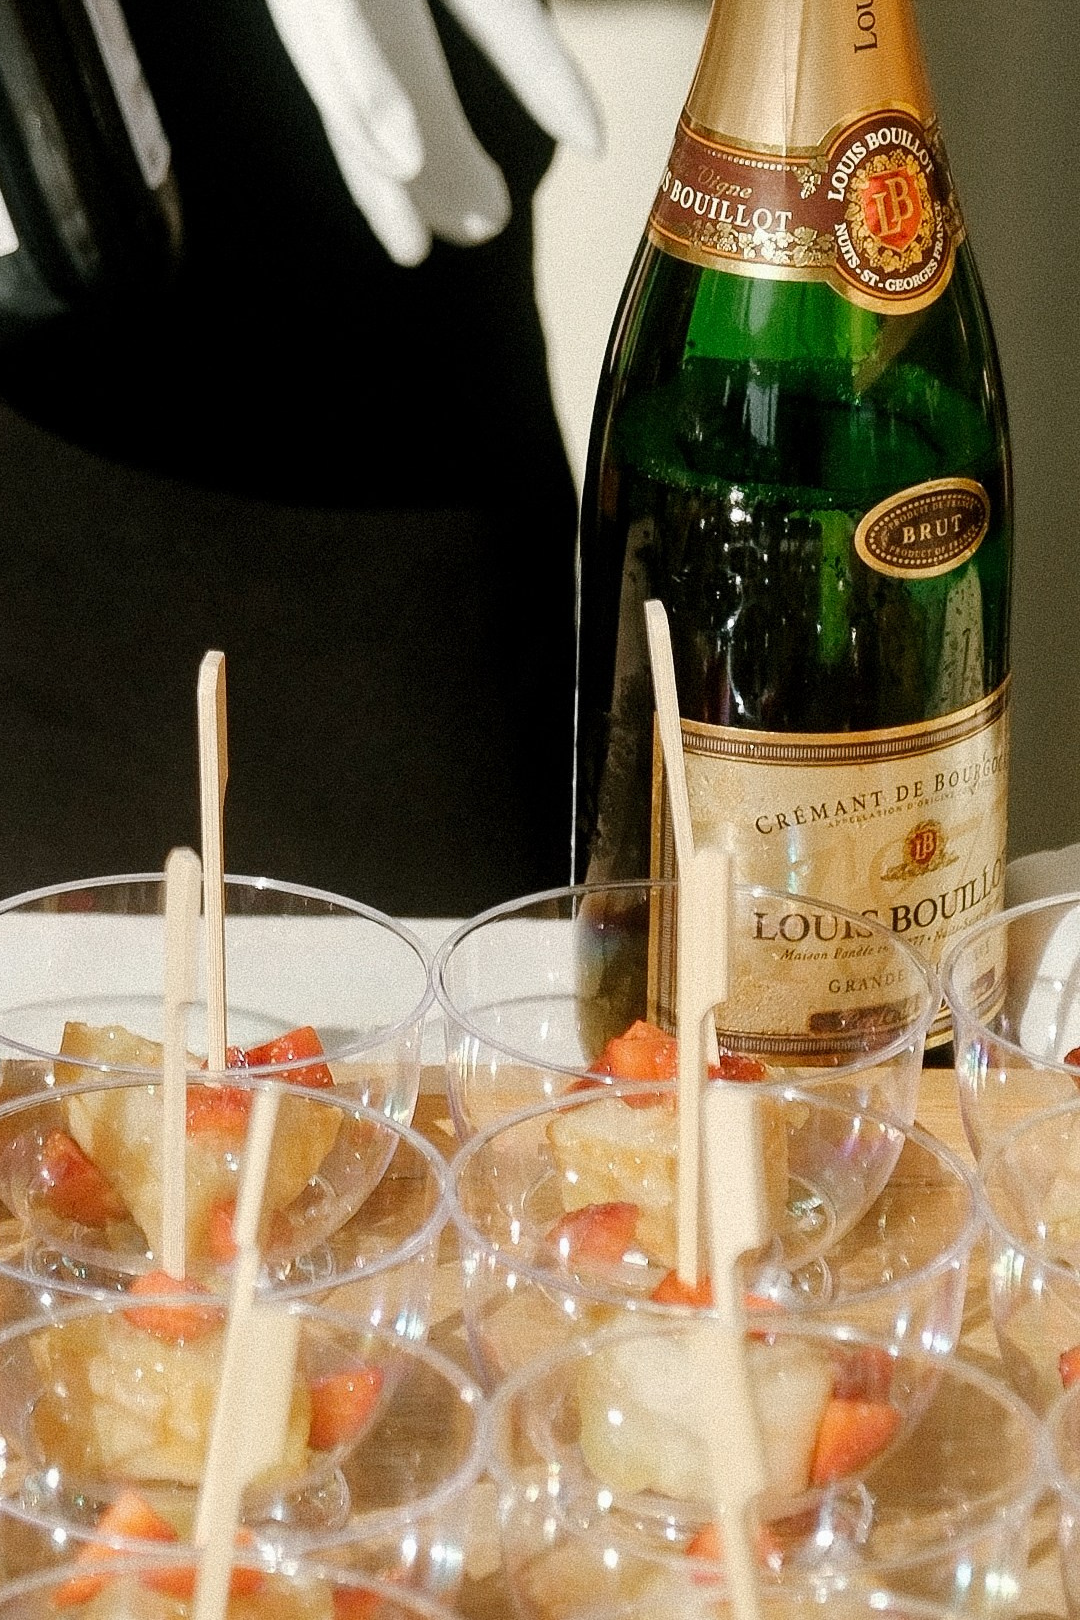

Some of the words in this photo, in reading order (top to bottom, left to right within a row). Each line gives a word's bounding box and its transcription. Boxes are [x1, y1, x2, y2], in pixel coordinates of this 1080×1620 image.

[827, 141, 867, 202] LOUIS
[864, 127, 935, 174] BOUILLOT
[669, 179, 792, 232] BOUILLOT
[872, 176, 914, 237] LB
[932, 200, 944, 261] FRANCE
[902, 513, 963, 545] BRUT
[754, 789, 883, 835] CRÉMANT
[895, 780, 925, 803] DE
[752, 909, 879, 942] LOUIS
[780, 948, 829, 961] Maison
[828, 969, 906, 994] GRANDE
